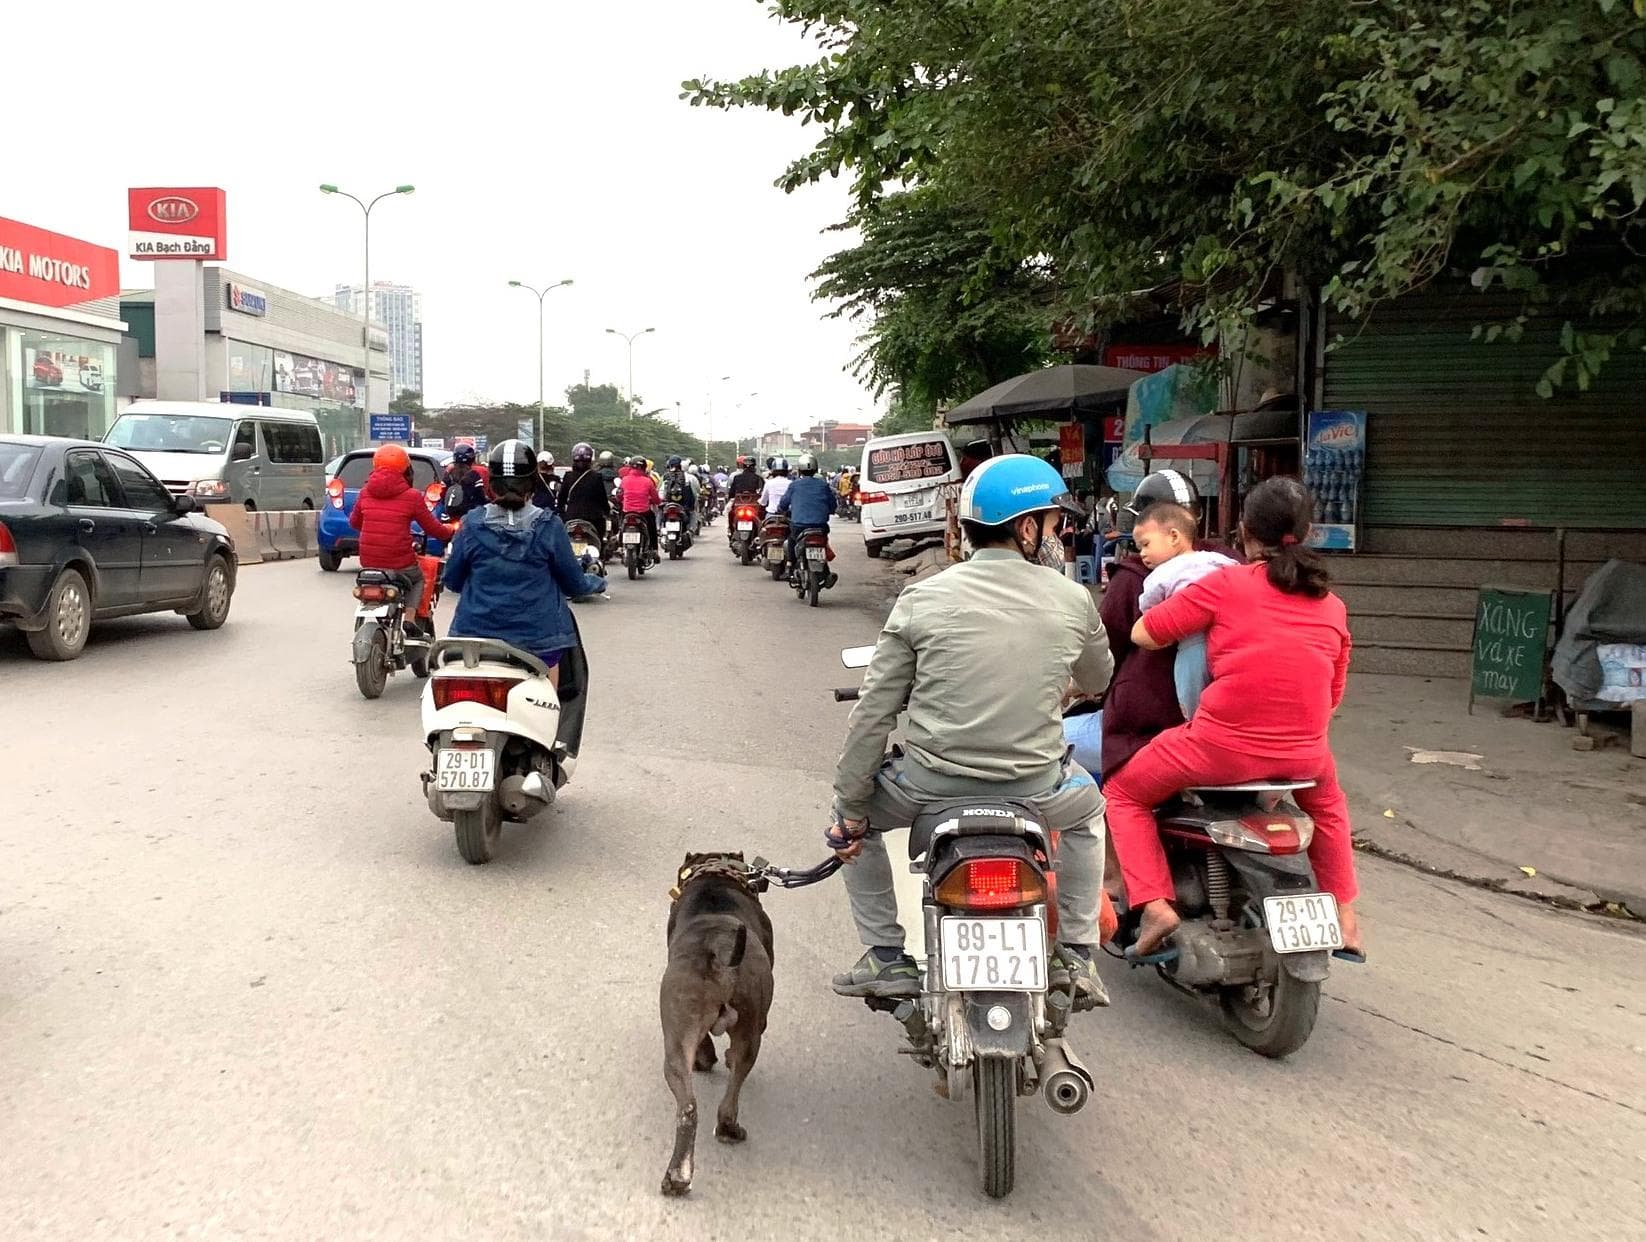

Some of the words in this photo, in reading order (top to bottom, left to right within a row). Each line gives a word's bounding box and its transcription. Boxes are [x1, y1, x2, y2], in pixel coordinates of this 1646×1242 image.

[155, 202, 190, 218] KIA
[135, 242, 154, 253] KIA
[156, 242, 181, 254] Bạch
[184, 239, 210, 254] Đằng
[0, 245, 24, 275] KIA
[29, 253, 91, 290] MOTORS
[441, 771, 490, 788] 570.87
[962, 808, 1015, 818] HONDA
[957, 922, 1027, 951] 89-L1
[1277, 923, 1339, 949] 130.28
[951, 955, 1039, 986] 178.21
